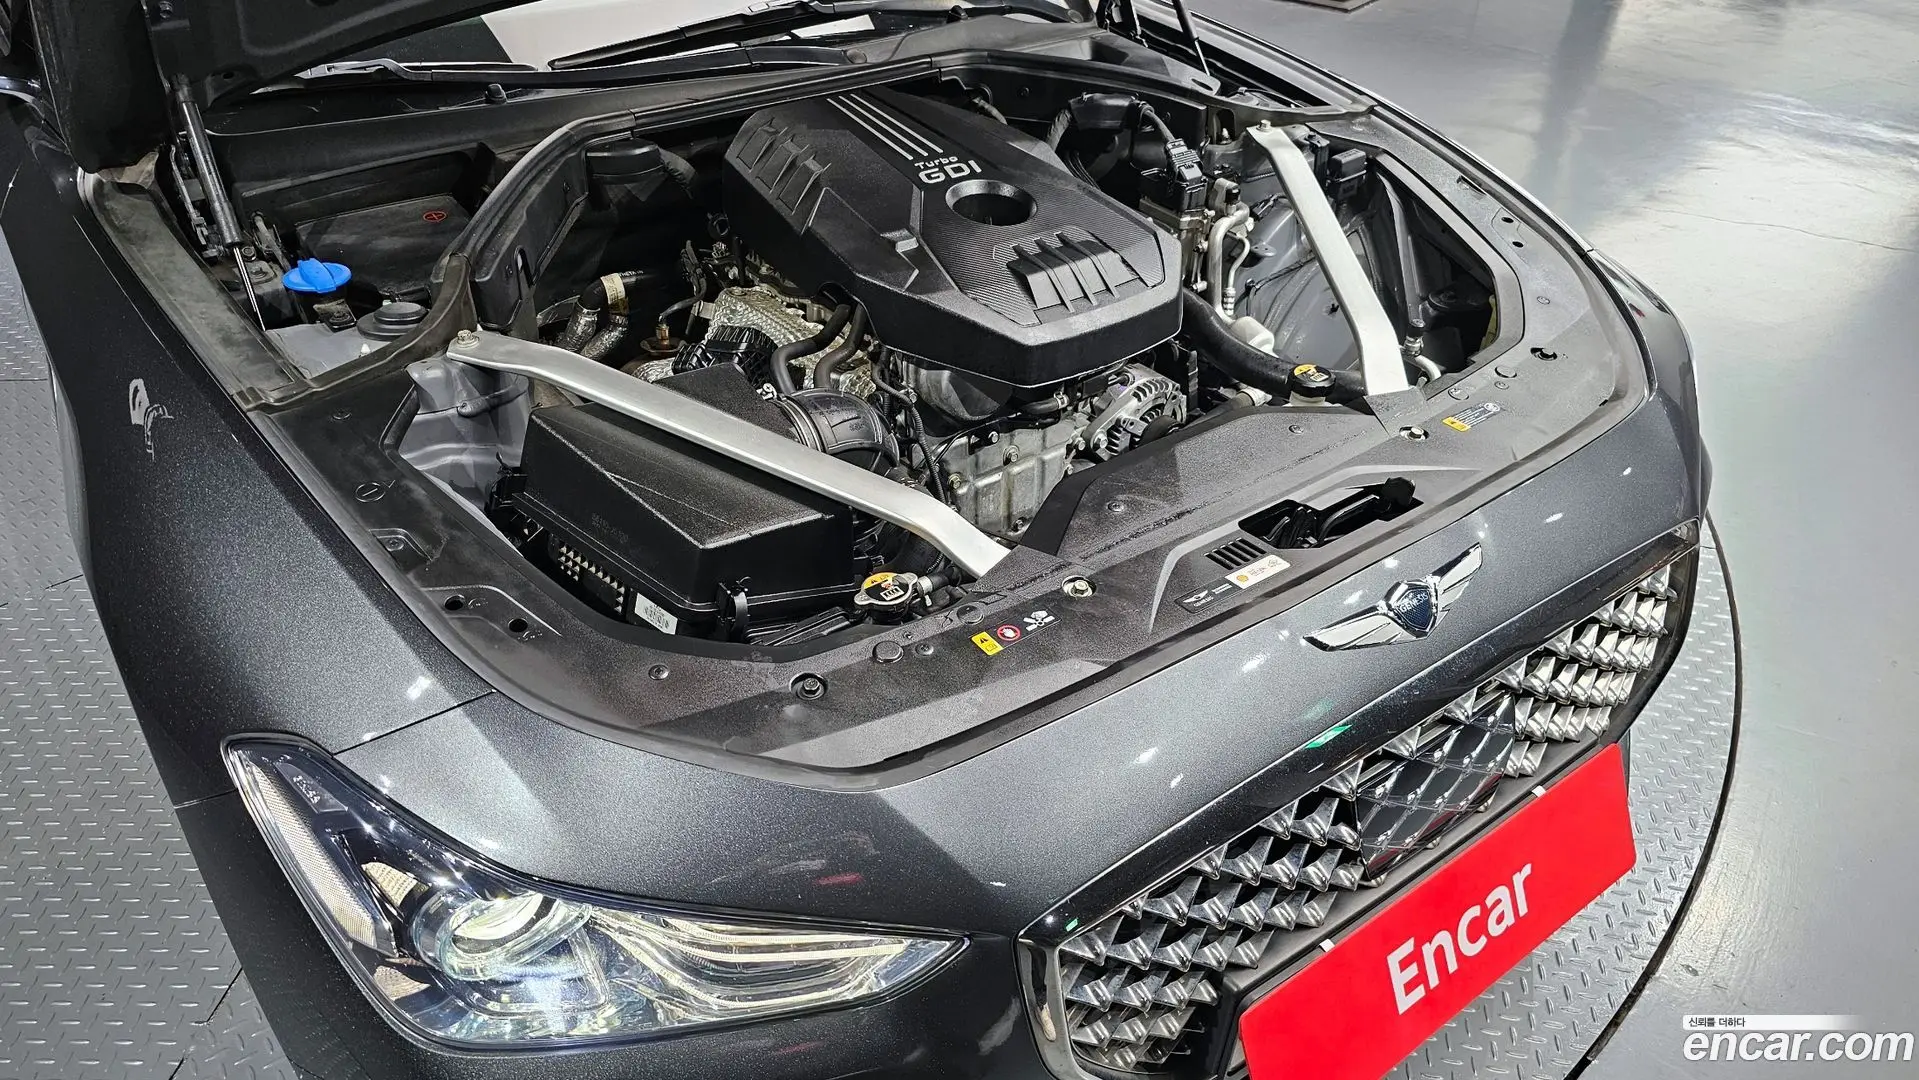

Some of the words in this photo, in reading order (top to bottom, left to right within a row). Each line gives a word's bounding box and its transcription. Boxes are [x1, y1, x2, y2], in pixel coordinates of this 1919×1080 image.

[914, 156, 958, 169] Turbo
[918, 160, 982, 183] GDI
[1400, 592, 1429, 612] GENESIS
[1386, 863, 1532, 1015] Encar
